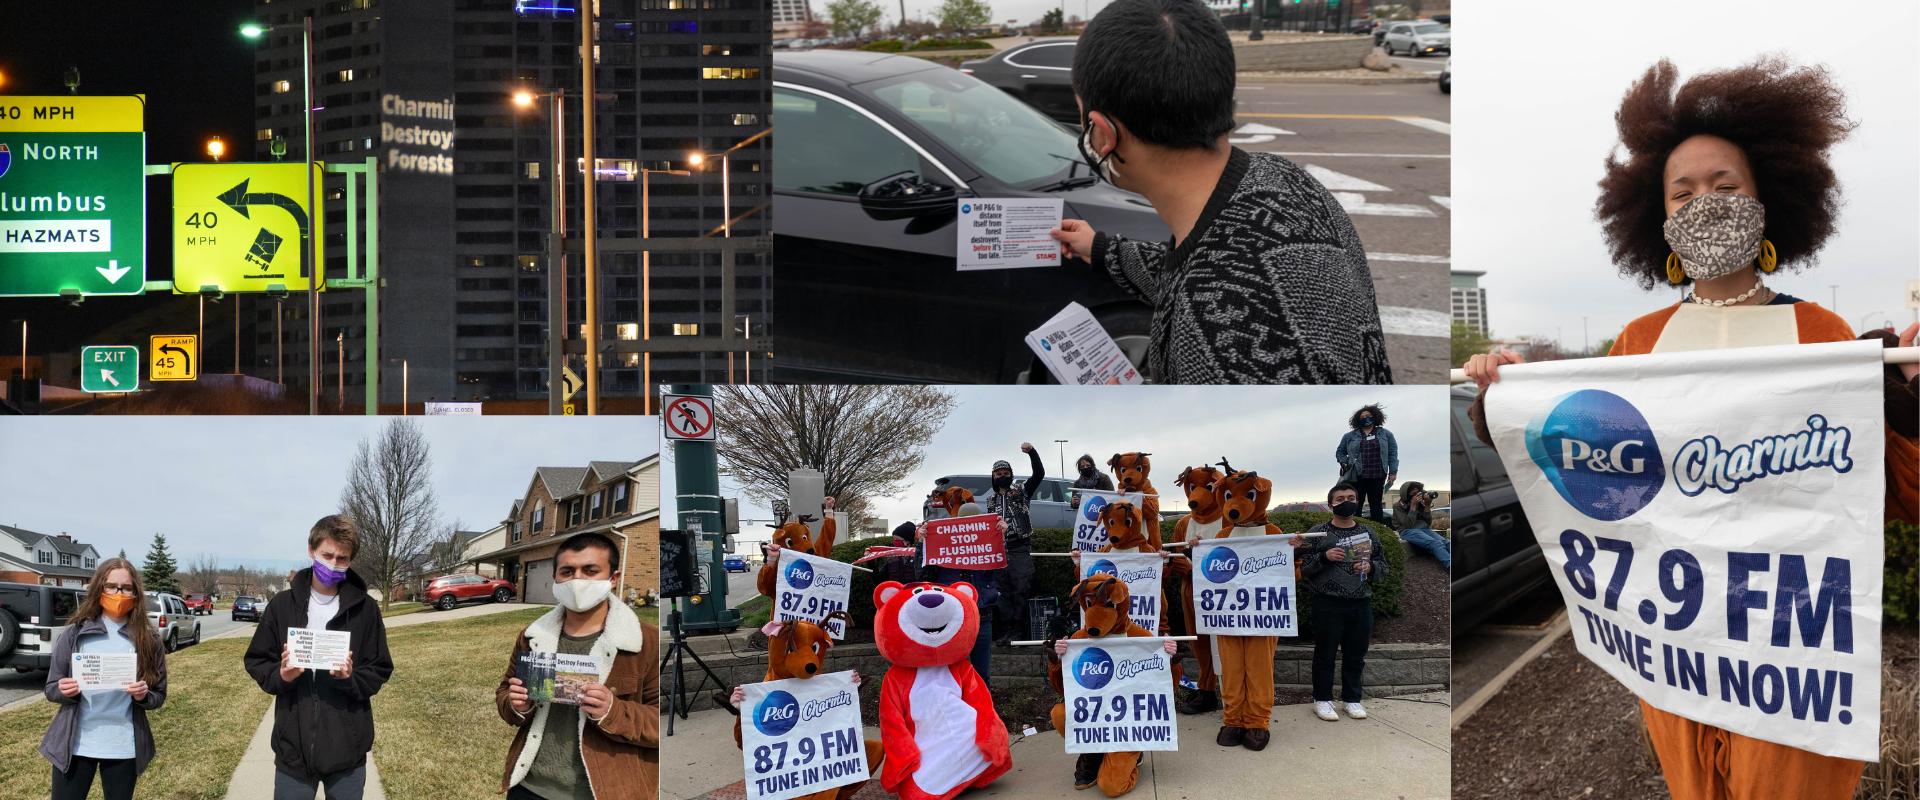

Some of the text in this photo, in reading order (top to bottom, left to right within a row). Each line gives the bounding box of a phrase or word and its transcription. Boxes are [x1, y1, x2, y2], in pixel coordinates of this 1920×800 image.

[0, 106, 75, 120] 40 MPH
[381, 121, 454, 150] Destroy
[389, 149, 454, 176] Forests
[984, 203, 995, 211] P&G
[185, 211, 218, 229] 40
[6, 229, 100, 243] HAZMATS
[986, 227, 1001, 235] forest
[187, 237, 217, 246] MPH
[973, 243, 991, 252] before
[94, 351, 126, 362] EXIT
[156, 357, 175, 368] 45
[1560, 413, 1853, 497] P&G Charmin
[936, 522, 990, 535] CHARMIN:
[950, 533, 978, 545] STOP
[1076, 541, 1097, 553] TUNE
[939, 543, 993, 556] FLUSHING
[928, 553, 1004, 565] OUR FORESTS
[1208, 551, 1287, 575] P&G Charmin
[790, 567, 847, 588] P&G Charmin
[1120, 567, 1157, 584] Charmin
[1200, 586, 1290, 611] 87.9 FM
[1558, 528, 1854, 655] 87.9 FM
[780, 591, 818, 615] 87.9
[1129, 595, 1155, 616] FM
[1202, 614, 1291, 629] TUNE IN NOW!
[1081, 653, 1164, 680] P&G Charmin
[1578, 604, 1854, 726] TUNE IN NOW!
[762, 690, 852, 723] P&G Charmin
[1073, 693, 1170, 724] 87.9 FM
[1074, 725, 1171, 744] TUNE IN NOW!
[753, 727, 859, 774] 87.9 FM
[755, 757, 862, 797] TUNE IN NOW!
